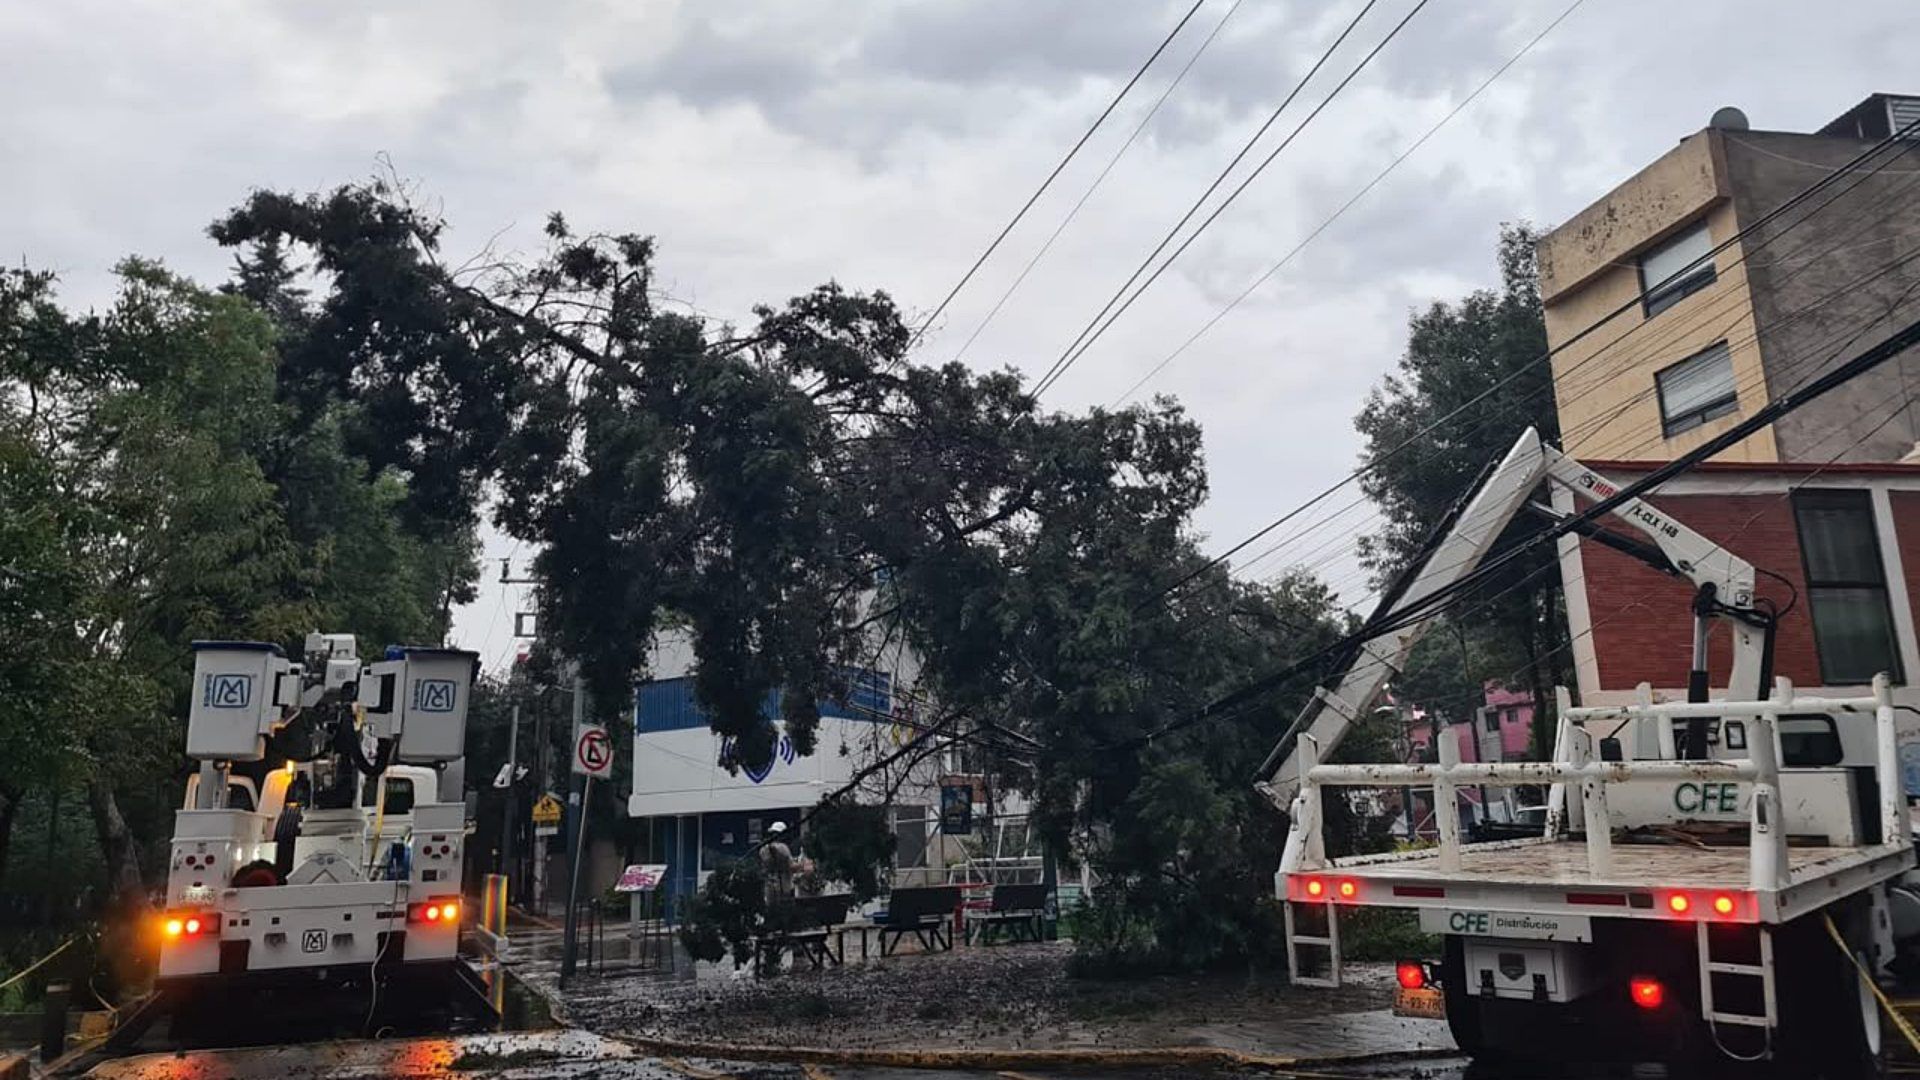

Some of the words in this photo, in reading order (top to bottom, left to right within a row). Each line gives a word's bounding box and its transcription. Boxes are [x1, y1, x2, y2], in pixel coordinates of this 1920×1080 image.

[1675, 782, 1738, 812] CFE
[1449, 912, 1488, 932] CFE
[1496, 917, 1558, 930] Distribución
